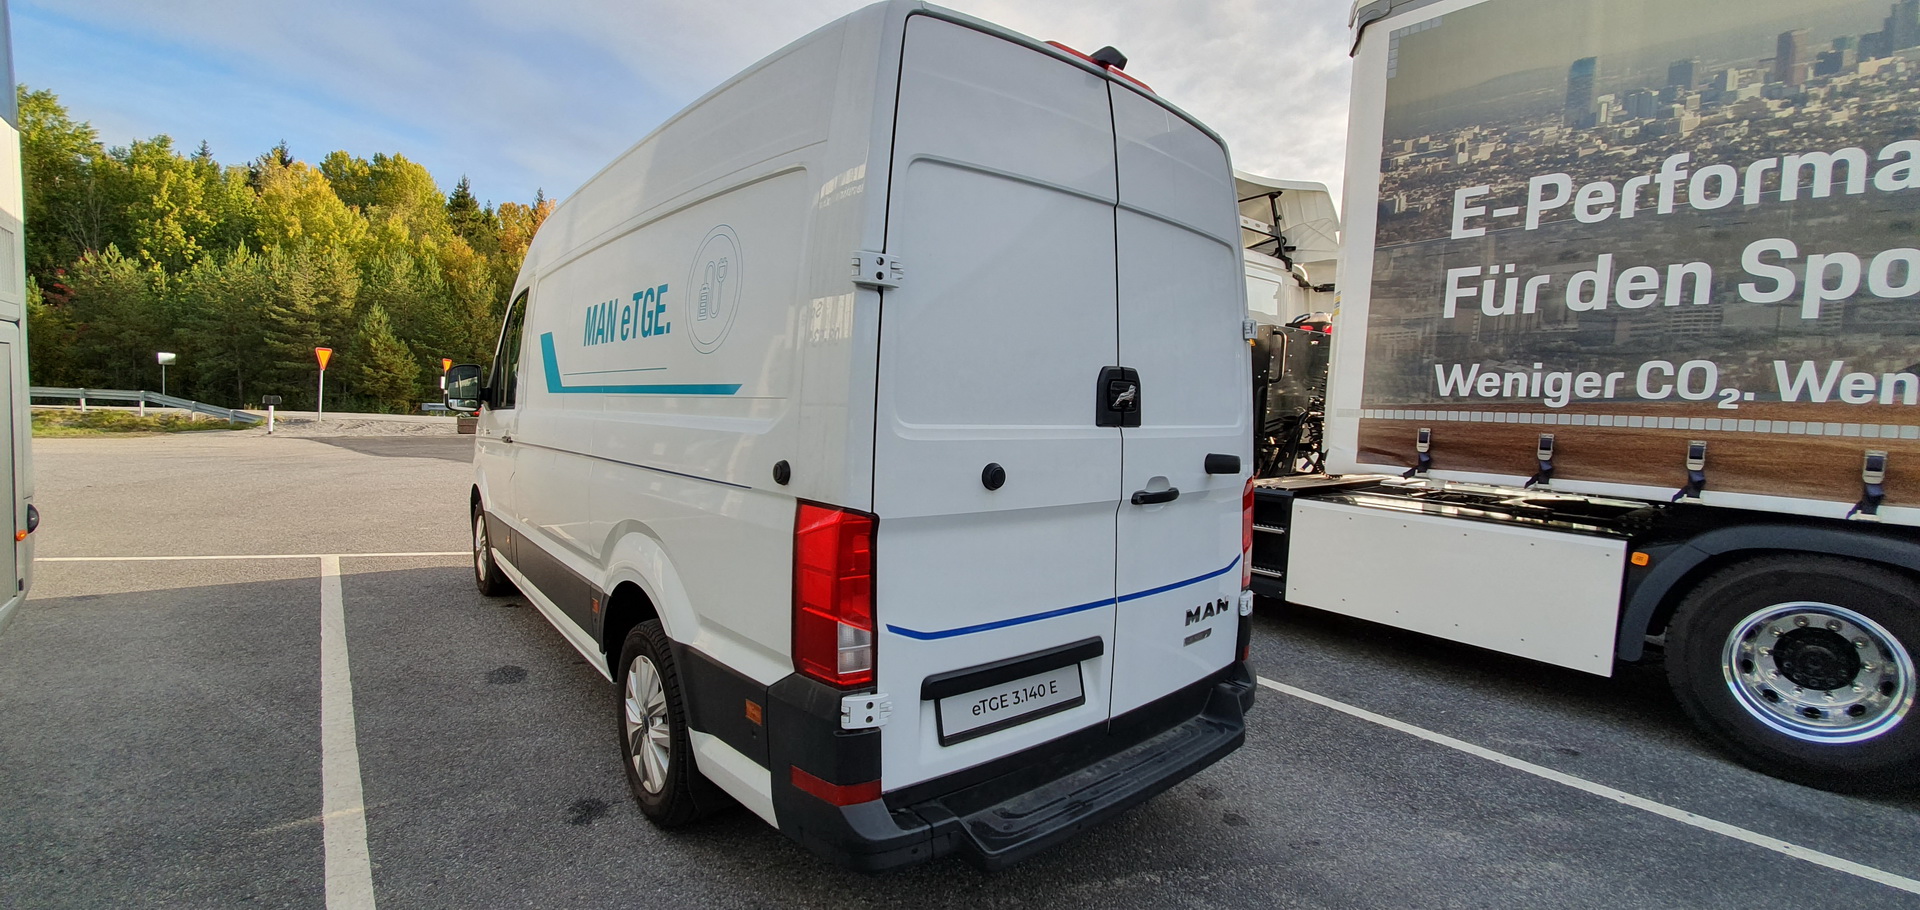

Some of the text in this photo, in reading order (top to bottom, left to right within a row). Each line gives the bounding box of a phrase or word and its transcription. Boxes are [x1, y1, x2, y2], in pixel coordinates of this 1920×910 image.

[1451, 138, 1920, 240] E-Performa
[1443, 237, 1920, 319] Für den Spo
[583, 283, 671, 347] MAN eTGE.
[1434, 362, 1625, 408] Weniger
[1774, 360, 1919, 406] Wen
[1185, 596, 1229, 627] MAN
[972, 680, 1059, 716] eTGE 3.140 E
